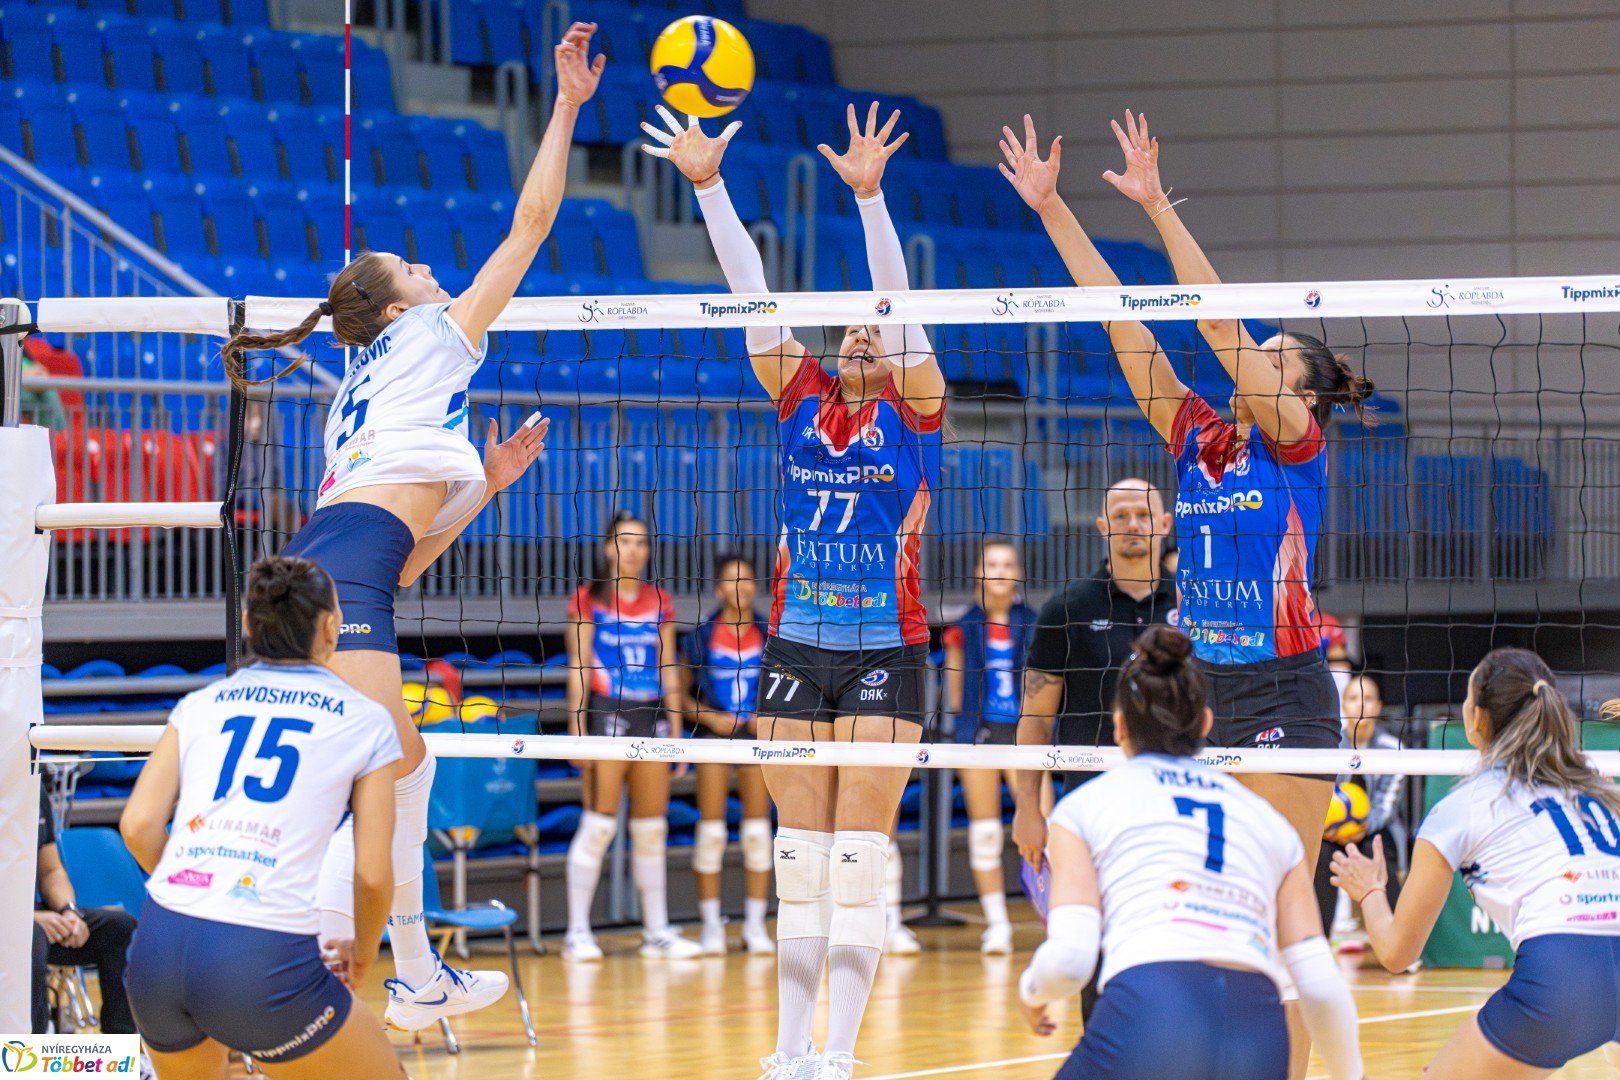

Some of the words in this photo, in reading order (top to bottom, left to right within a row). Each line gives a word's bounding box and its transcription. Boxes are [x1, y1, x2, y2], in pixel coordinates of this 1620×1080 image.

[699, 301, 778, 317] TippmixPRO
[1022, 298, 1066, 308] RÖPLABDA
[1120, 293, 1201, 310] TippmixPRO
[349, 331, 392, 378] OVIĆ
[336, 374, 371, 441] 5
[787, 455, 895, 485] ippmixPRO
[807, 488, 861, 534] 77
[794, 526, 886, 565] FATUM
[1199, 524, 1212, 569] 1
[812, 591, 860, 609] Többet
[862, 591, 888, 608] ad!
[1183, 598, 1263, 610] ROPERTY
[215, 686, 345, 716] KRIVOSHIYSKA
[765, 672, 800, 702] 77
[213, 715, 315, 803] 15
[752, 746, 816, 760] TippmixPRO
[208, 819, 283, 842] LINAMAR
[1173, 796, 1225, 874] 7
[1529, 792, 1620, 857] 10
[187, 845, 278, 868] sportmarket
[396, 914, 420, 926] TEAM
